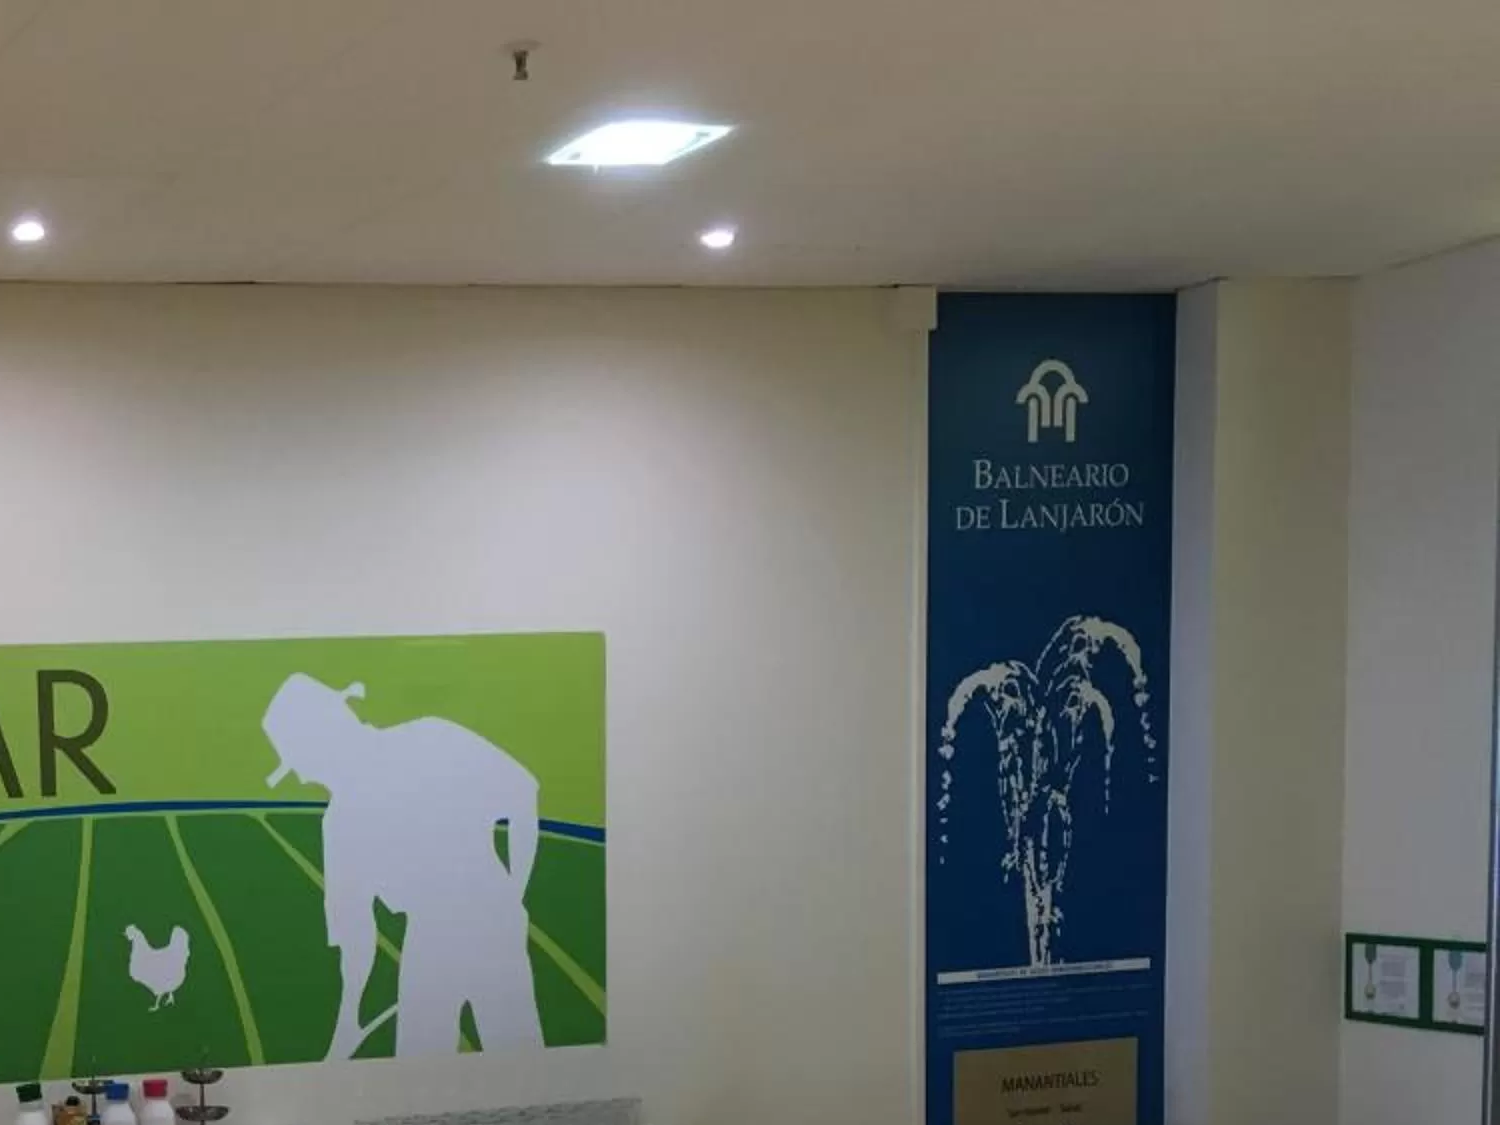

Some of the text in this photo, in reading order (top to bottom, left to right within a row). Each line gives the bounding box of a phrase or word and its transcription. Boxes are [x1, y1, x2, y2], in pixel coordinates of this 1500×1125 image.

[972, 458, 1130, 490] BALNEARIO
[955, 497, 1145, 533] DE LANJARÓN
[1001, 1070, 1100, 1093] MANANTIALES
